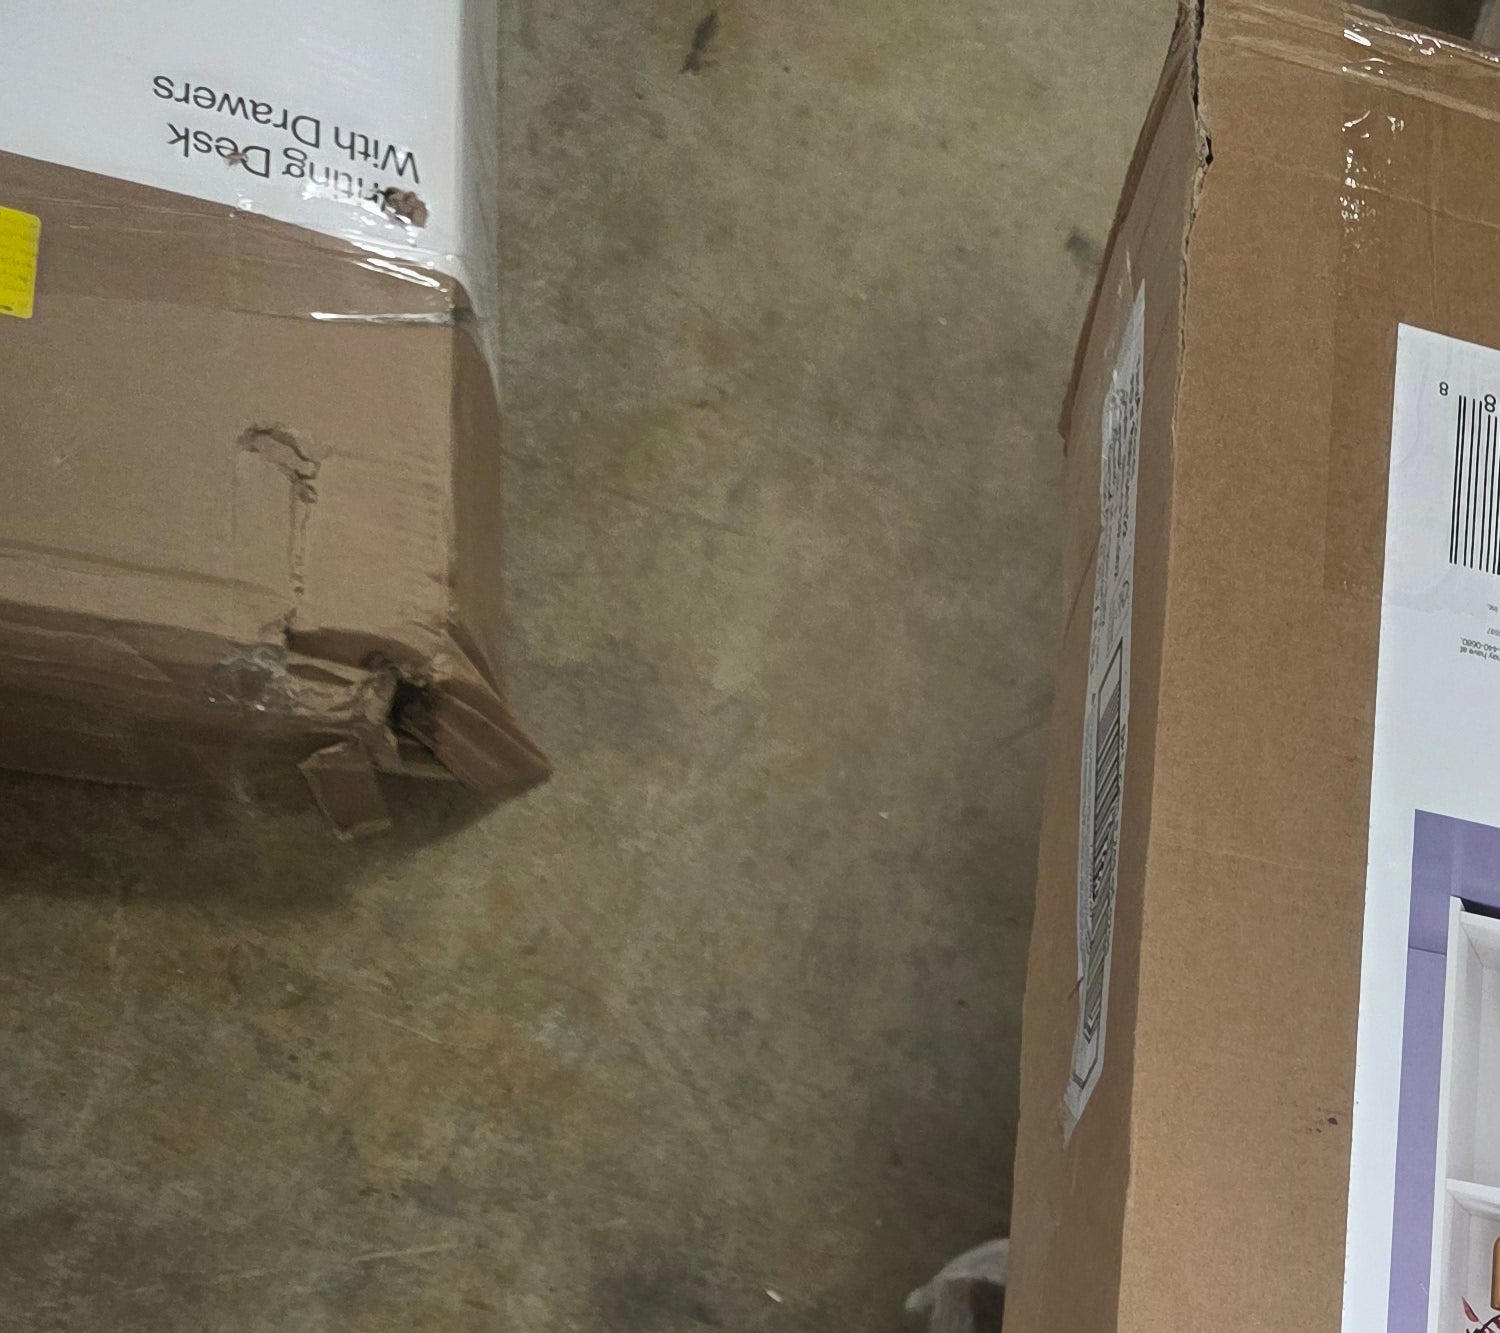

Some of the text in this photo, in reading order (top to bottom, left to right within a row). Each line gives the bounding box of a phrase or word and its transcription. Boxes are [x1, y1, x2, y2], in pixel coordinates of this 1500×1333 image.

[152, 76, 420, 185] With Drawers
[167, 123, 390, 213] riting Desk
[1439, 382, 1450, 397] 8
